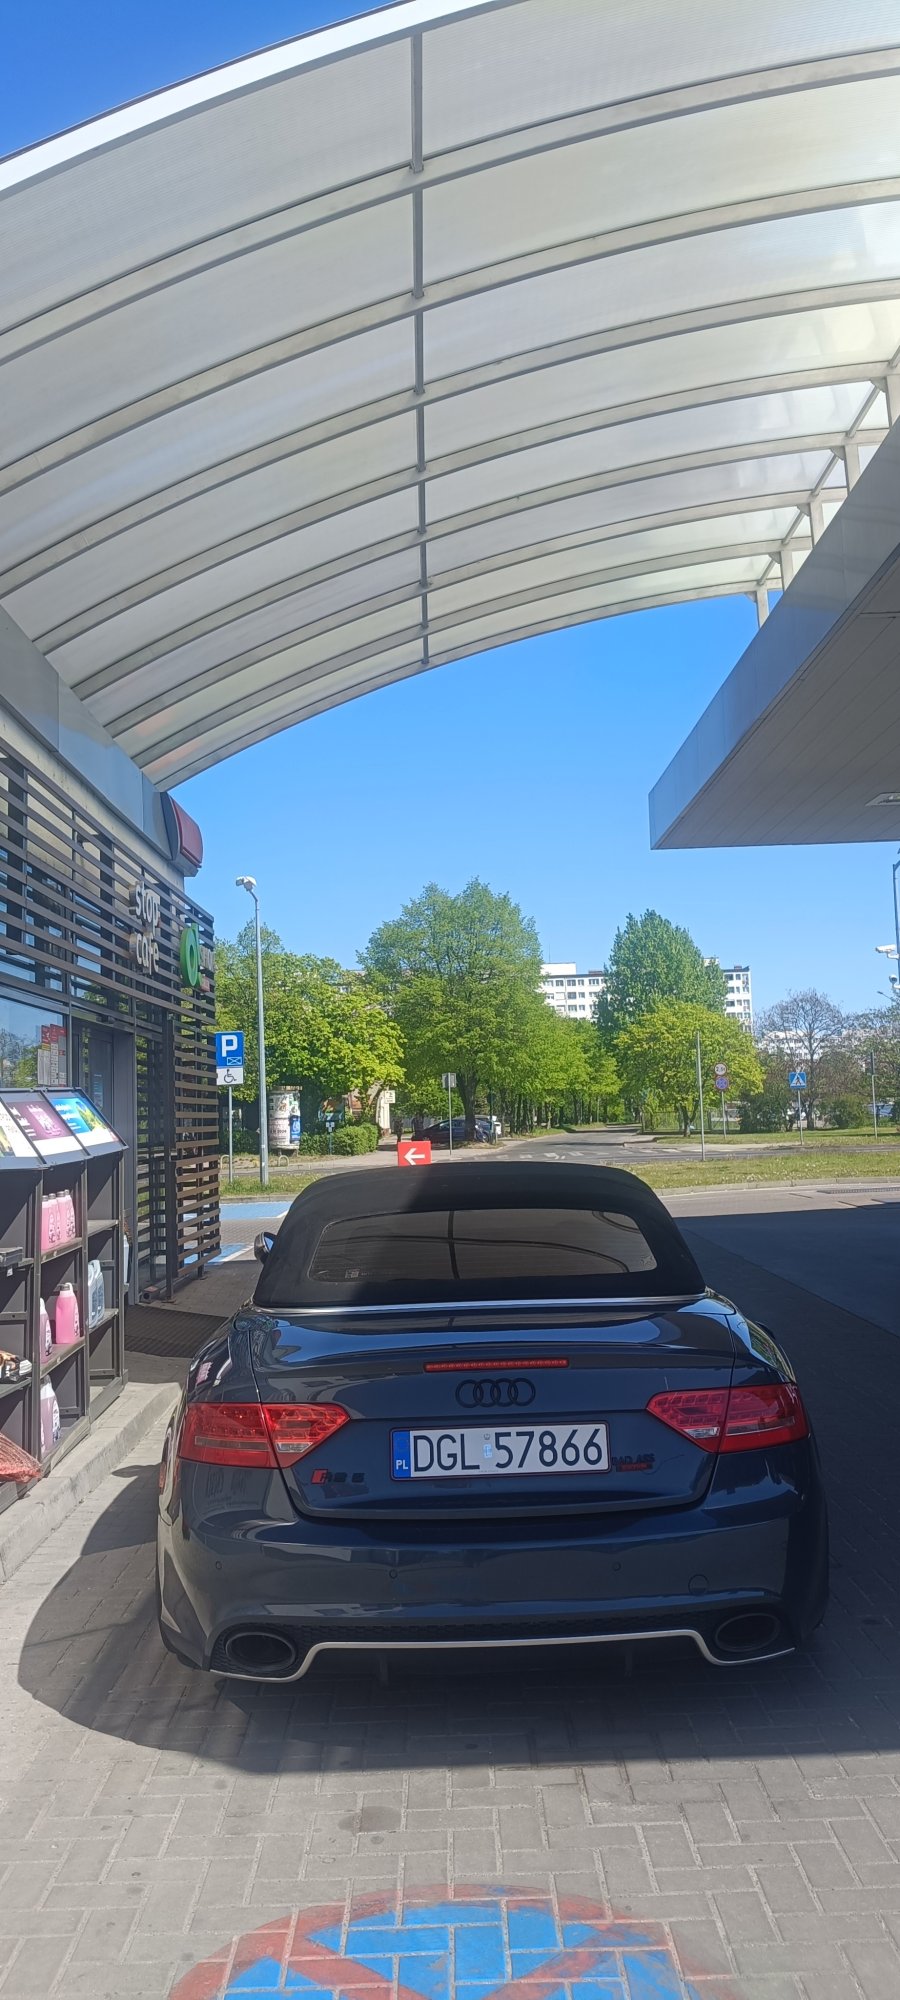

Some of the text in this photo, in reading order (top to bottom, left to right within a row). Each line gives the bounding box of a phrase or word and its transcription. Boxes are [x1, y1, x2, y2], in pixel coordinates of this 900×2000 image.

[136, 881, 160, 936] stop
[136, 933, 159, 975] cafe
[221, 1035, 238, 1057] P
[396, 1459, 409, 1470] PL
[413, 1428, 602, 1472] DGL 57866
